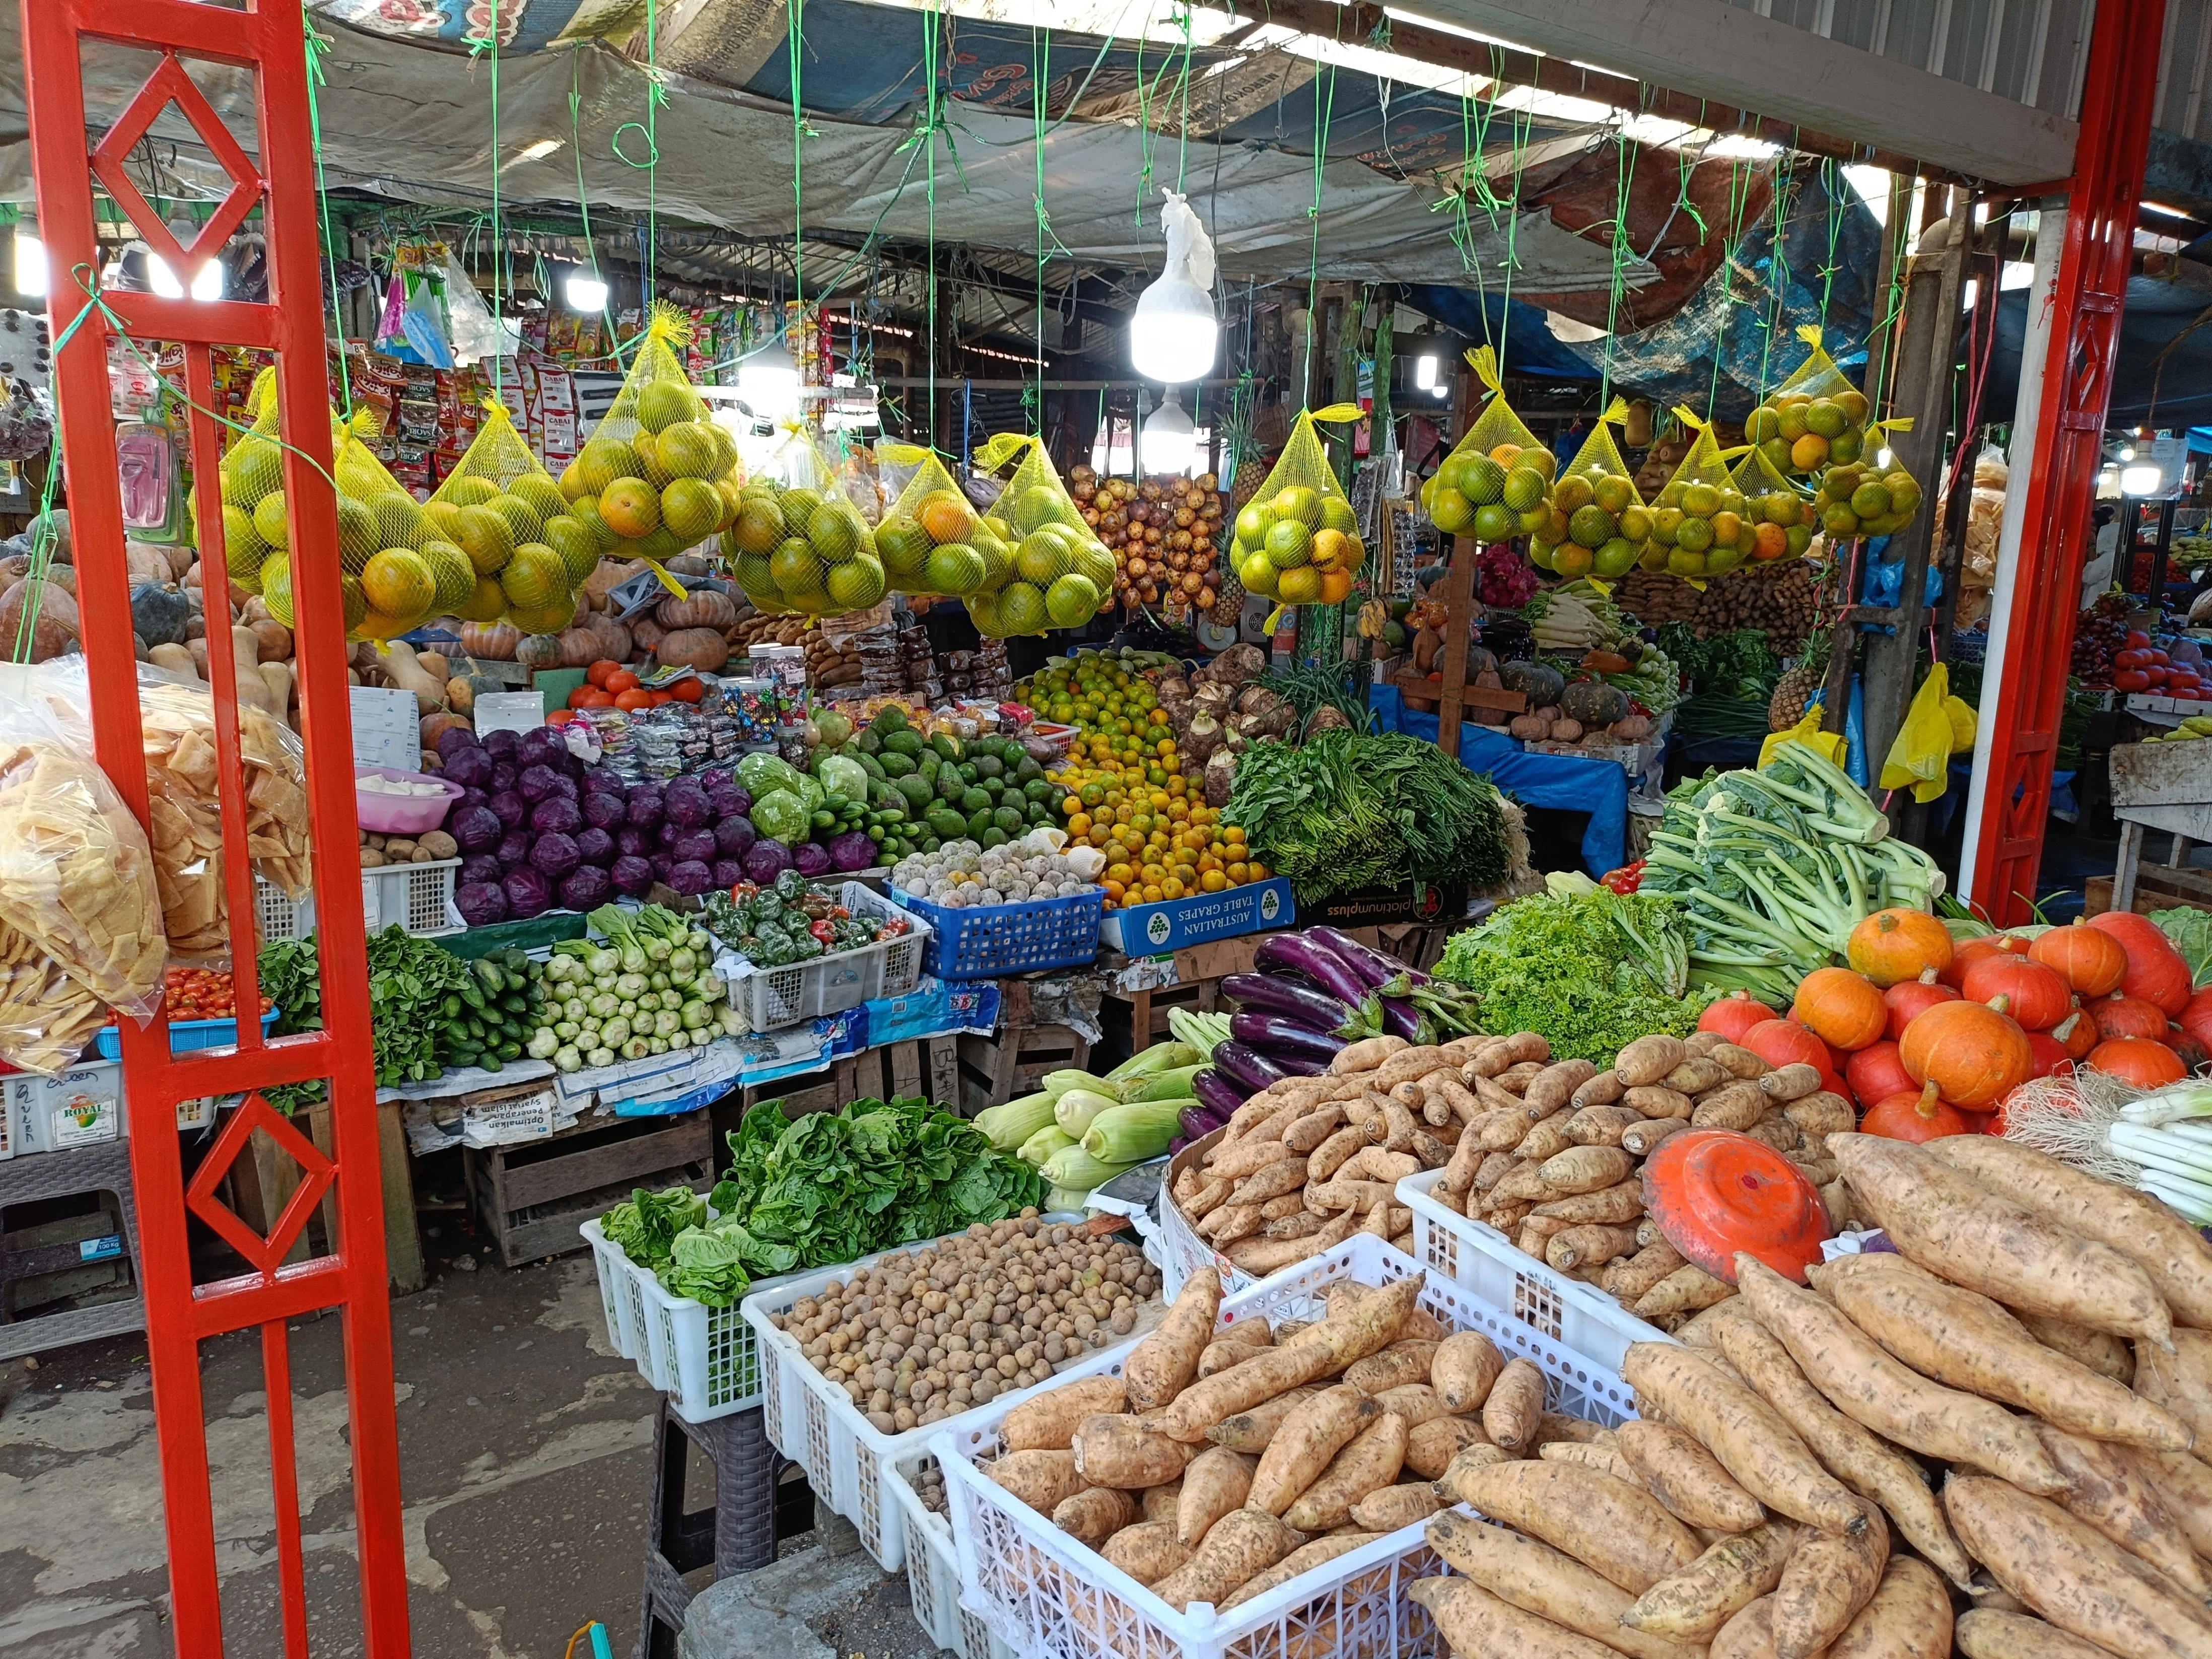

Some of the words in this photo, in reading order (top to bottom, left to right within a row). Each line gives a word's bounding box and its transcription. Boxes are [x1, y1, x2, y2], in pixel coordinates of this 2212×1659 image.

[408, 385, 431, 393] SAORI
[409, 427, 433, 437] SAORI
[400, 452, 423, 462] SAORI
[1223, 895, 1255, 913] TABLE
[1327, 898, 1411, 918] platinumpluss
[1179, 903, 1220, 922] GRAPES
[1185, 910, 1251, 936] AUSTRALIAN
[64, 1103, 105, 1119] ROYAL
[481, 1103, 507, 1113] Islam
[508, 1098, 541, 1111] Syariat
[489, 1117, 544, 1129] Optimalkan
